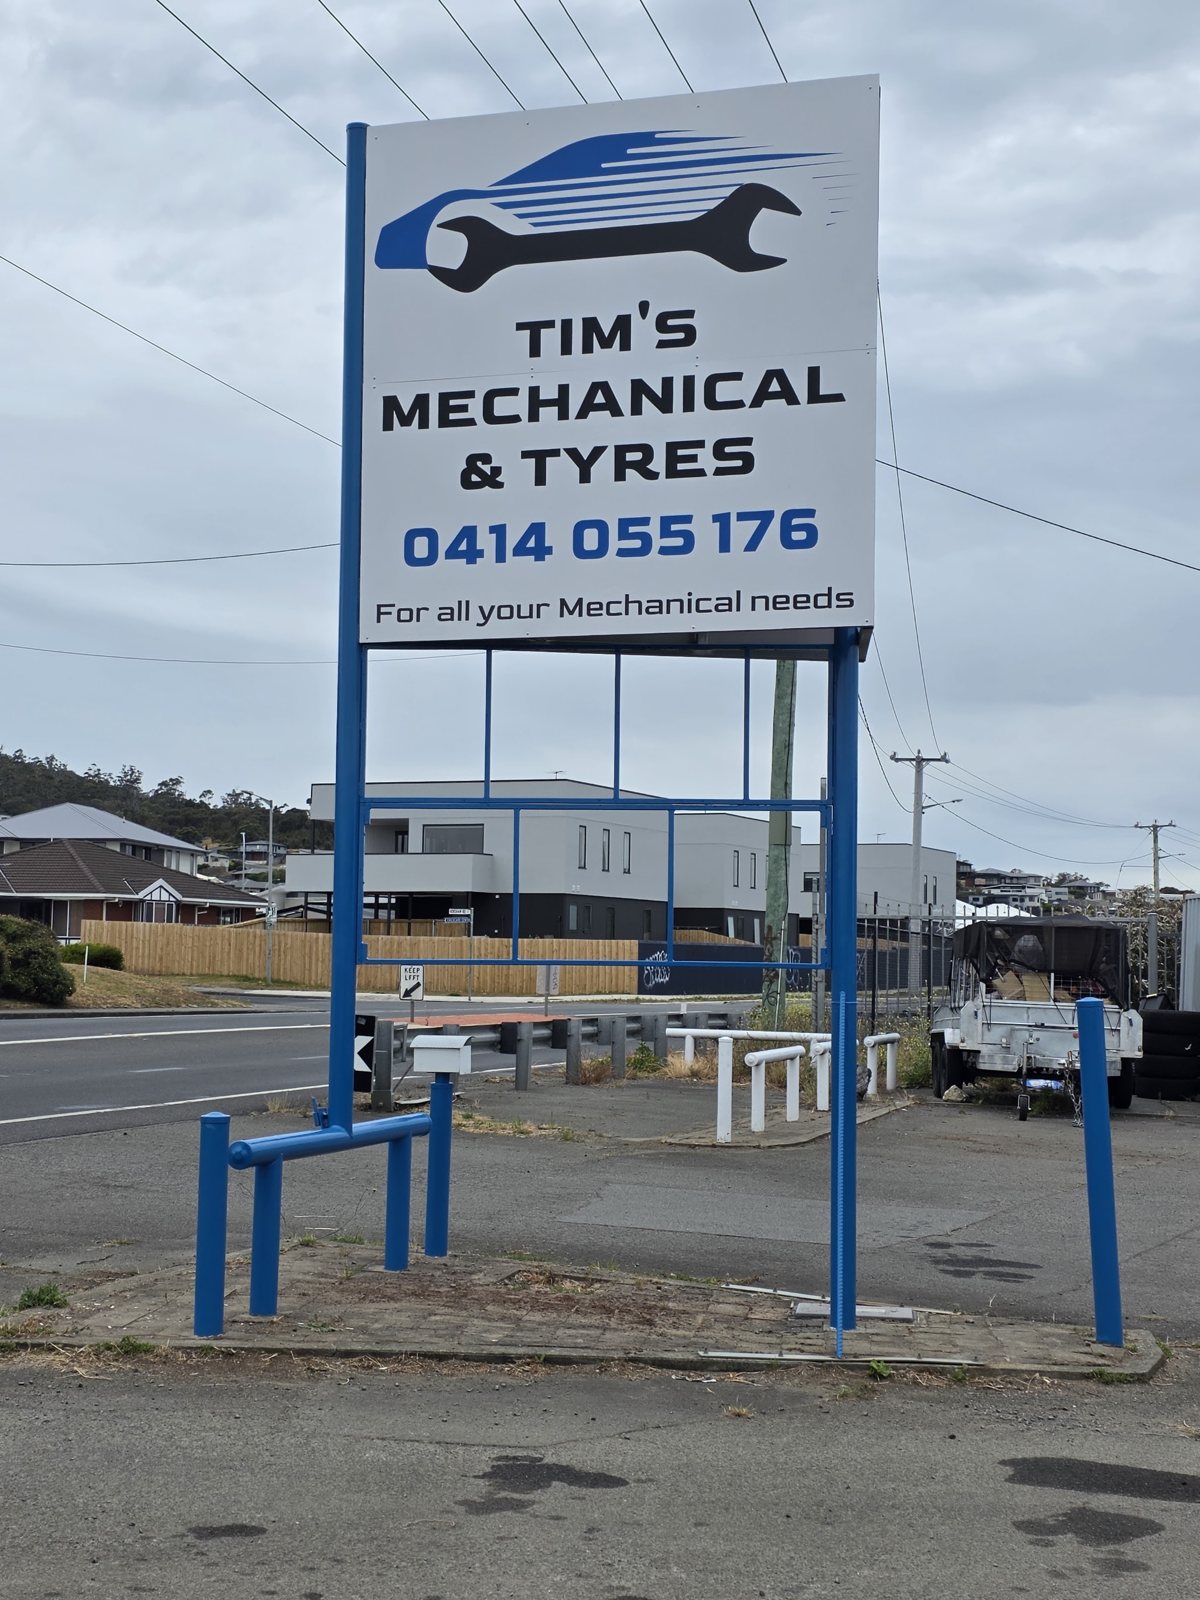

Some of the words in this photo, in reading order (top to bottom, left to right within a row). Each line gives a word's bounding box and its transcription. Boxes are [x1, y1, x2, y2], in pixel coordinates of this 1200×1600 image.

[515, 299, 698, 359] TIM'S
[382, 365, 847, 432] MECHANICAL
[459, 452, 505, 491] &
[520, 436, 755, 487] TYRES
[403, 521, 554, 568] 0414
[572, 514, 696, 560] 055
[711, 508, 819, 554] 176
[376, 603, 430, 624] For
[436, 599, 471, 622] all
[475, 602, 551, 628] your
[559, 589, 742, 619] Mechanical
[750, 586, 855, 612] needs
